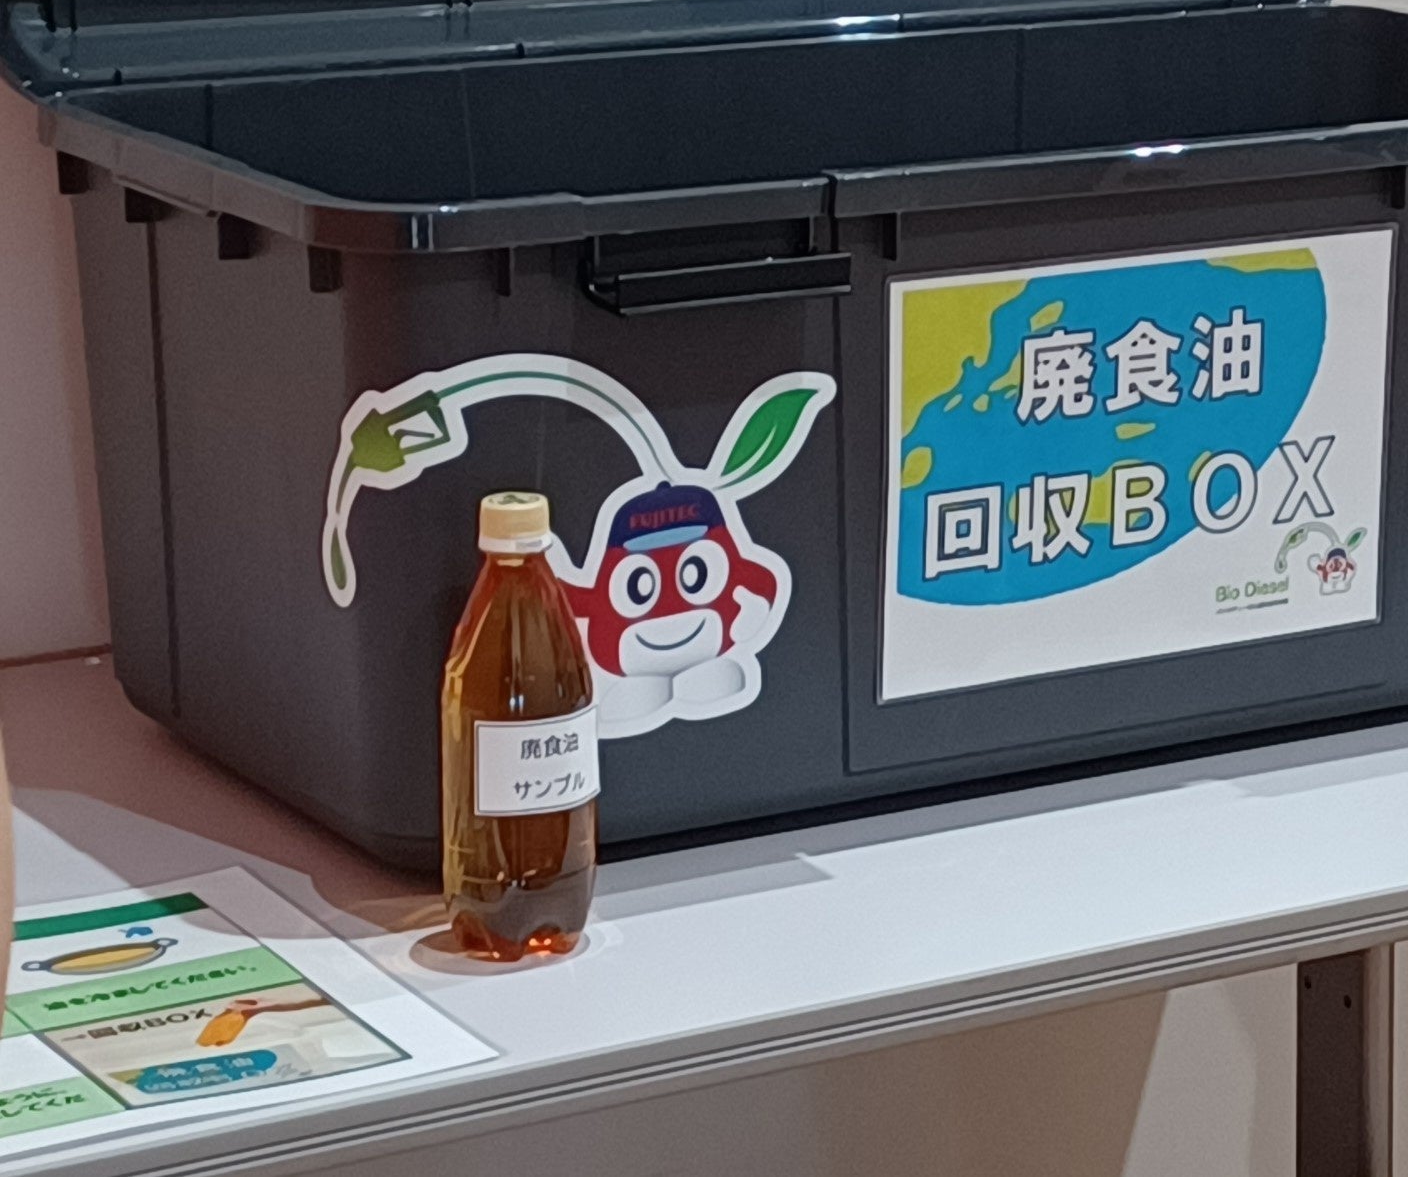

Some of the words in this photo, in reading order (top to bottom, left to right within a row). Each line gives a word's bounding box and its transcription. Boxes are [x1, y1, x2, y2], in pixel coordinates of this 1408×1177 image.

[1016, 307, 1266, 425] 廃食油
[629, 504, 699, 530] FUJITEC
[922, 435, 1336, 581] 回収BOX
[1215, 582, 1240, 603] Bio
[1244, 575, 1290, 598] Diesel
[520, 732, 580, 760] 廃食油
[513, 771, 586, 801] サンプル
